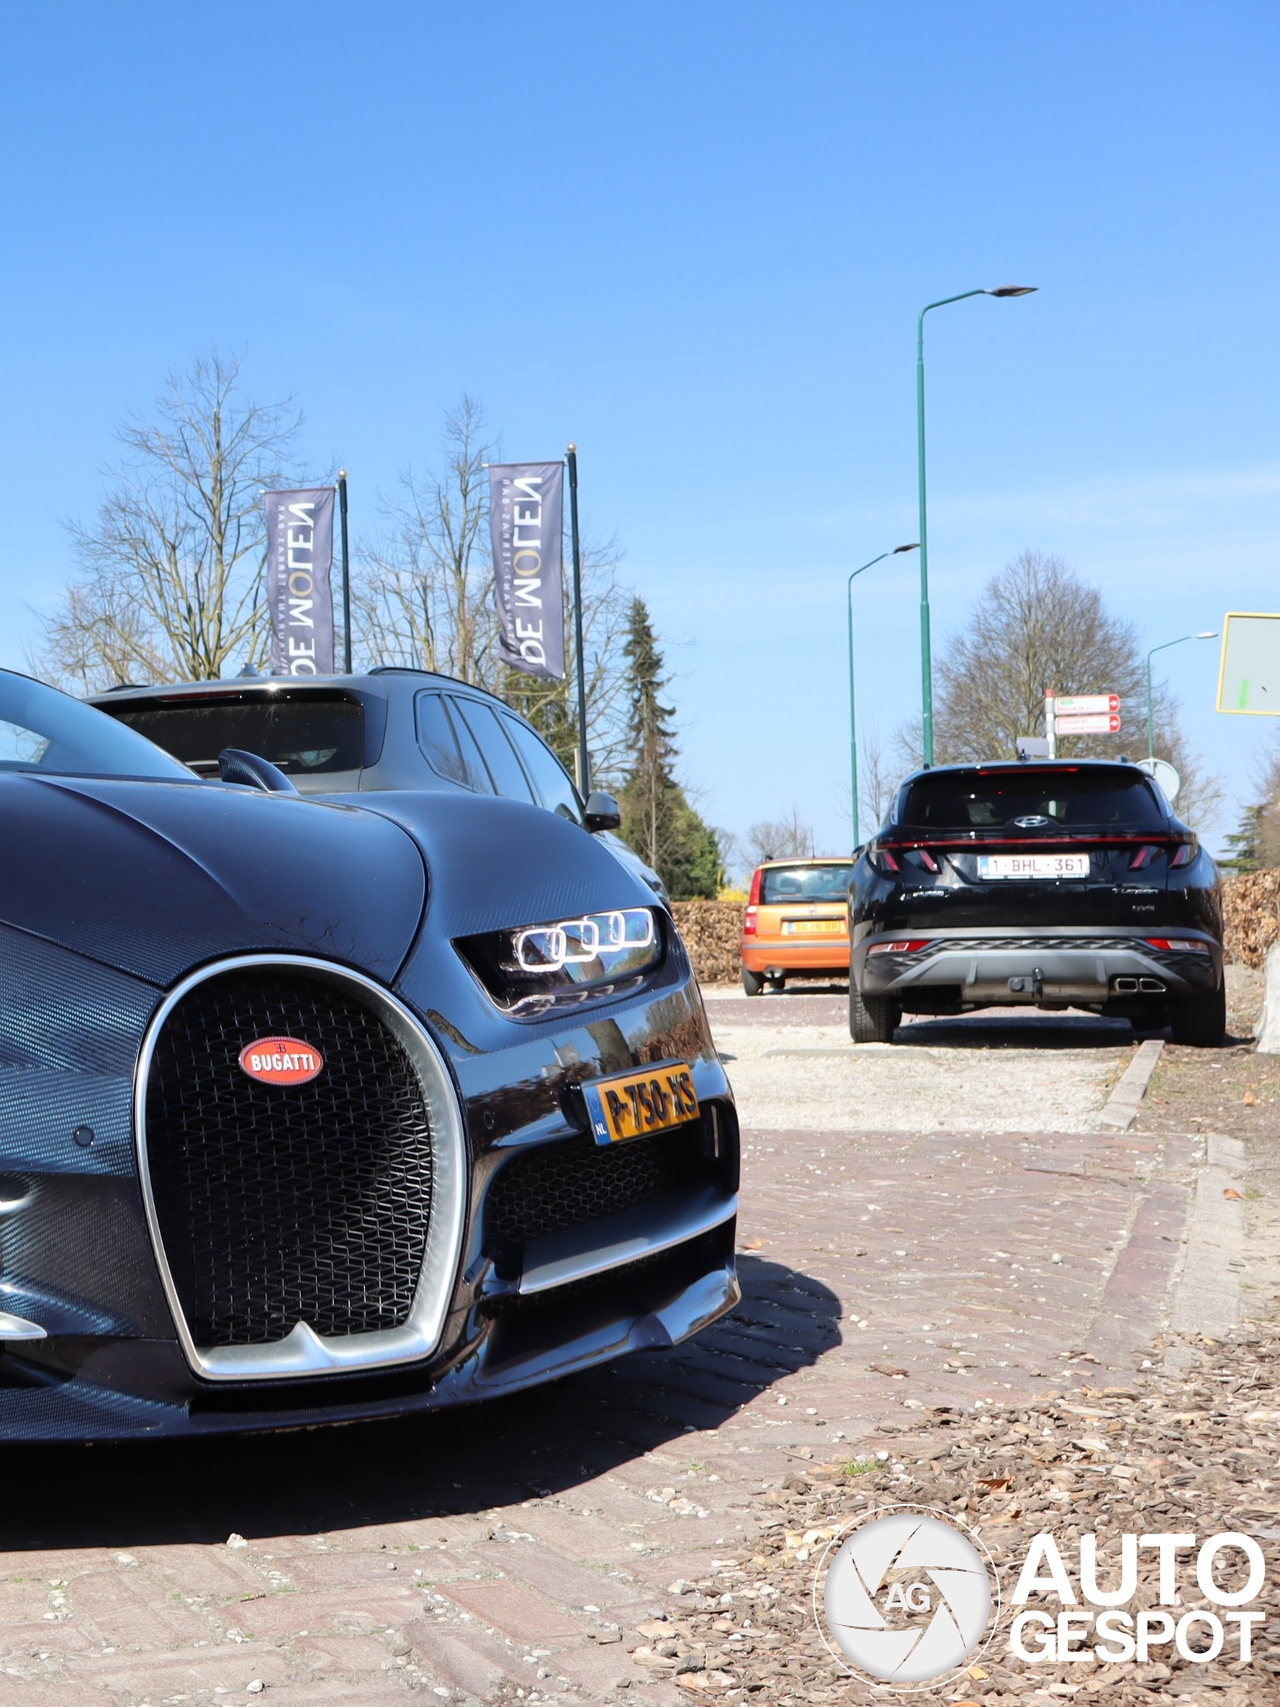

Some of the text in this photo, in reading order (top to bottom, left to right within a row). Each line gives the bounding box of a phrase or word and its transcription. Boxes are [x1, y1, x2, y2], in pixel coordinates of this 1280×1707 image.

[250, 1053, 315, 1072] BUGATTI
[605, 1072, 697, 1137] P-750-XS
[595, 1122, 608, 1136] NL
